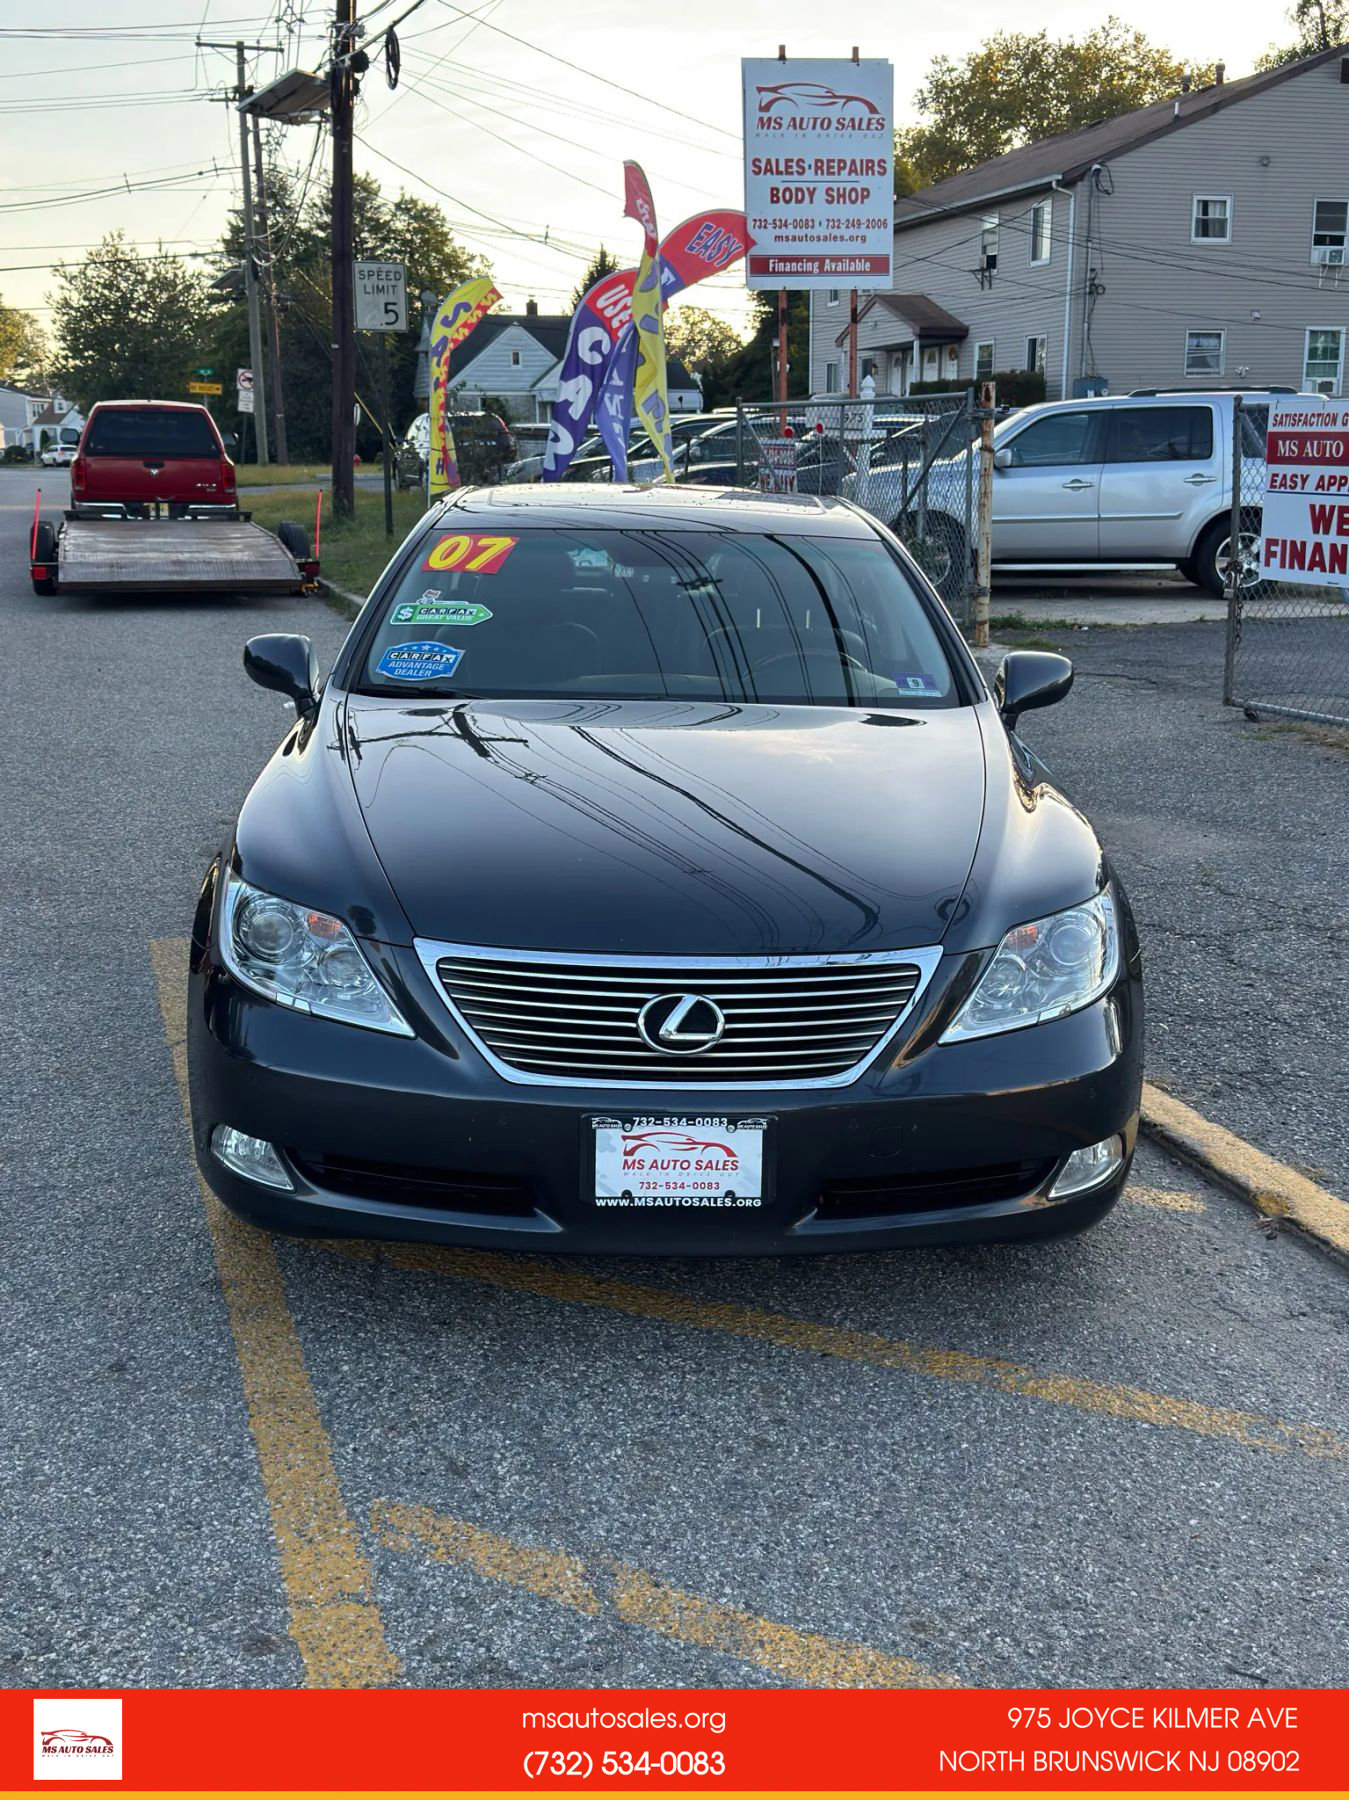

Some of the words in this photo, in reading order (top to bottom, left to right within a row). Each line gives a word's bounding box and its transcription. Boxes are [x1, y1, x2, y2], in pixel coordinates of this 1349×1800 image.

[756, 116, 783, 131] MS
[787, 116, 832, 131] AUTO
[835, 117, 886, 131] SALES
[751, 157, 806, 176] SALES
[814, 158, 887, 176] REPAIRS
[770, 187, 817, 205] BODY
[824, 187, 870, 205] SHOP
[752, 218, 815, 229] 732-534-0083
[826, 218, 888, 229] 732-249-2006
[685, 221, 744, 267] EASY
[774, 233, 867, 243] msautosales.org
[769, 259, 819, 273] Financing
[824, 259, 871, 272] Available
[358, 270, 402, 281] SPEED
[363, 284, 398, 295] LIMIT
[384, 302, 399, 326] 5
[1272, 412, 1339, 427] SATISFACTION
[1277, 440, 1299, 457] MS
[1303, 440, 1344, 458] AUTO
[1269, 473, 1310, 490] EASY
[1315, 474, 1349, 493] APP
[1309, 503, 1349, 537] WE
[429, 535, 515, 571] 07
[1264, 538, 1348, 575] FINAN
[419, 607, 477, 616] CARFAX
[390, 652, 456, 663] CARFAX
[388, 661, 446, 671] ADVANTAGE
[394, 669, 432, 677] DEALER
[633, 1117, 728, 1127] 732-534-0083
[623, 1159, 645, 1170] MS
[648, 1159, 691, 1170] AUTO
[694, 1159, 739, 1171] SALES
[639, 1181, 720, 1190] 732-534-0083
